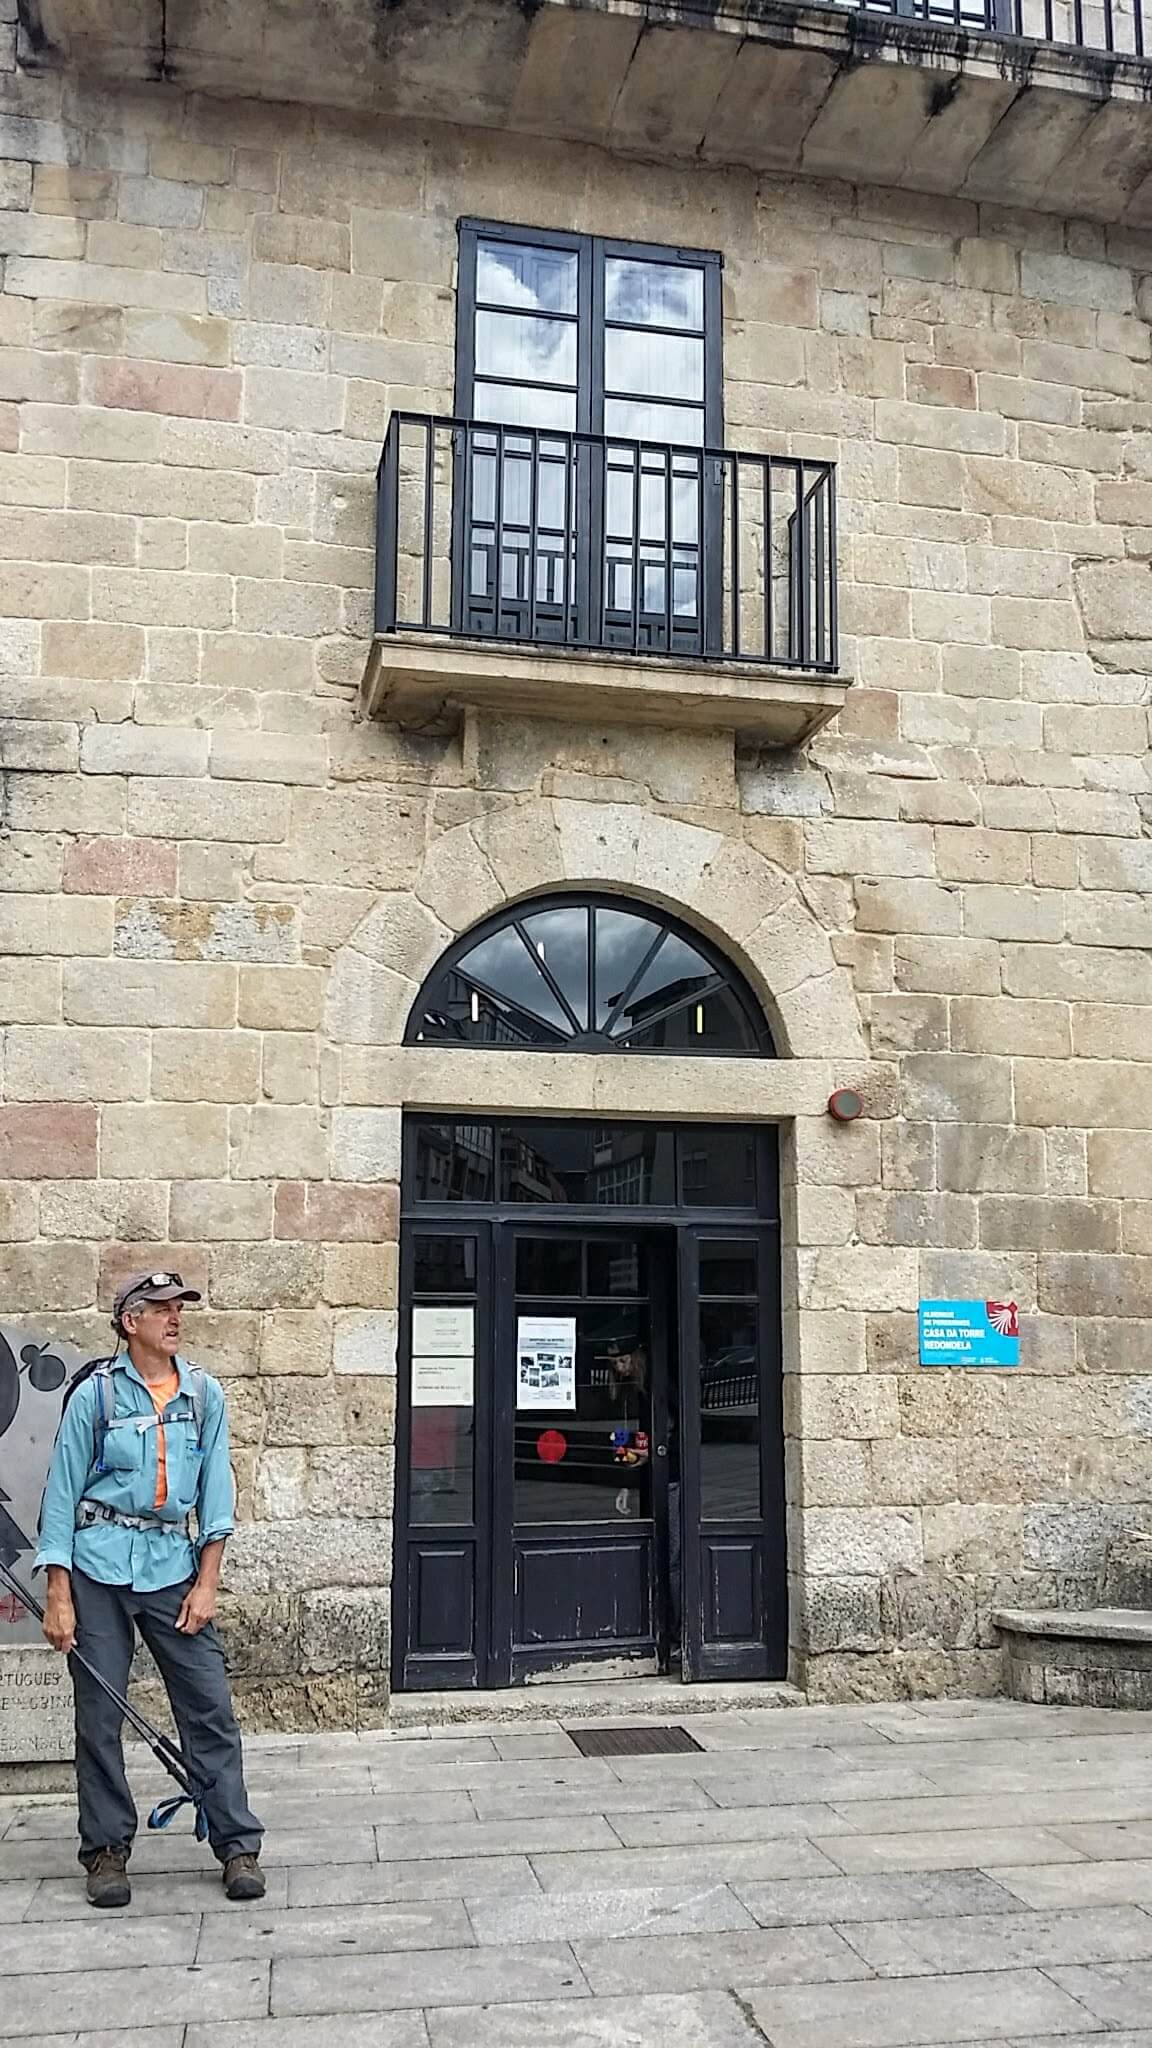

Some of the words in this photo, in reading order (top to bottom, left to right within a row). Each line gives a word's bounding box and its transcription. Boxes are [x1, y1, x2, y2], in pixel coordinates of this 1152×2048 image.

[924, 1328, 945, 1338] CASA
[946, 1328, 958, 1338] DA
[958, 1328, 985, 1339] TORRE
[924, 1340, 972, 1350] REDONDELA
